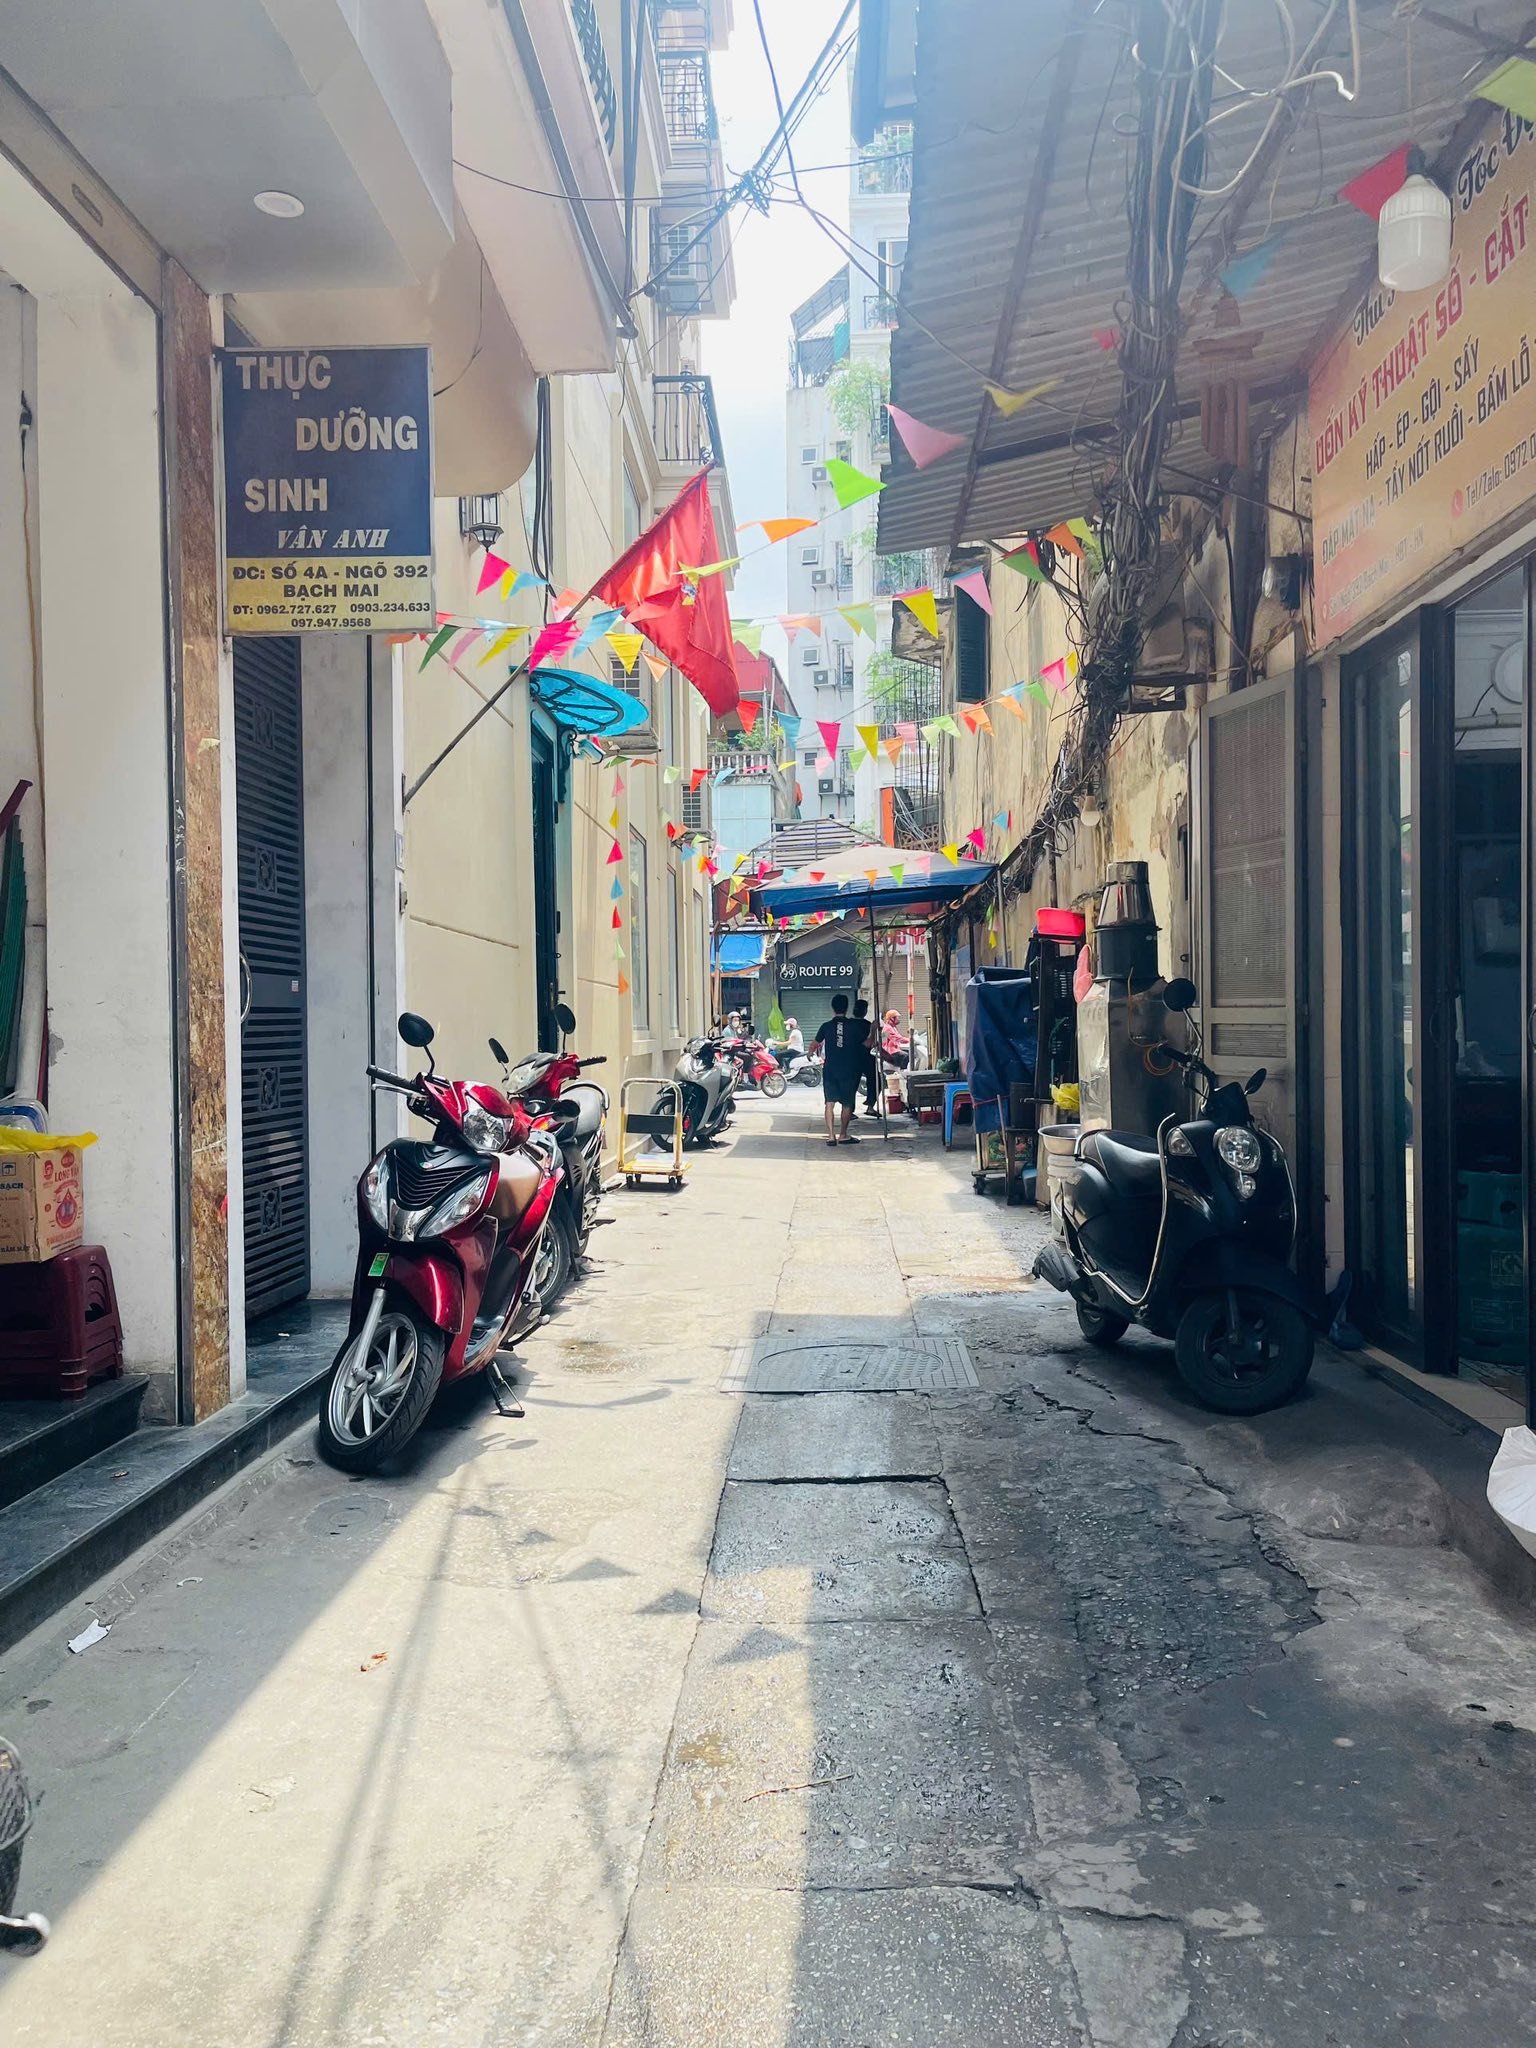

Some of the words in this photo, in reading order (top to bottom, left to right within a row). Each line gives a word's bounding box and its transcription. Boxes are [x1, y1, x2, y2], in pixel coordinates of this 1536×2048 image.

[1372, 311, 1429, 408] THUẬT
[1435, 253, 1463, 341] SỐ
[1484, 193, 1529, 285] CẮT
[235, 351, 331, 399] THỤC
[1366, 432, 1386, 480] HẤP
[1396, 410, 1410, 450] ÉP
[1454, 334, 1479, 392] SẤY
[1408, 435, 1430, 487] NỐT
[1434, 403, 1464, 464] RUỒI
[1477, 365, 1507, 425] BẤM
[1512, 334, 1530, 394] LỖ
[296, 407, 418, 451] DƯỠNG
[1504, 440, 1527, 479] 0972
[244, 478, 328, 512] SINH
[278, 525, 328, 549] VÂN
[332, 528, 390, 548] ANH
[233, 566, 265, 580] ĐC:
[272, 561, 297, 580] SỐ
[303, 566, 328, 579] 4A
[345, 562, 388, 579] NGÕ
[394, 565, 428, 578] 392
[233, 605, 253, 615] ĐT:
[256, 604, 336, 615] 0962.727.627
[350, 603, 430, 613] 0903.234.633
[284, 583, 337, 601] BẠCH
[343, 583, 379, 597] MAI
[291, 618, 371, 628] 097.947.9568
[799, 966, 837, 977] ROUTE
[839, 965, 853, 976] 99
